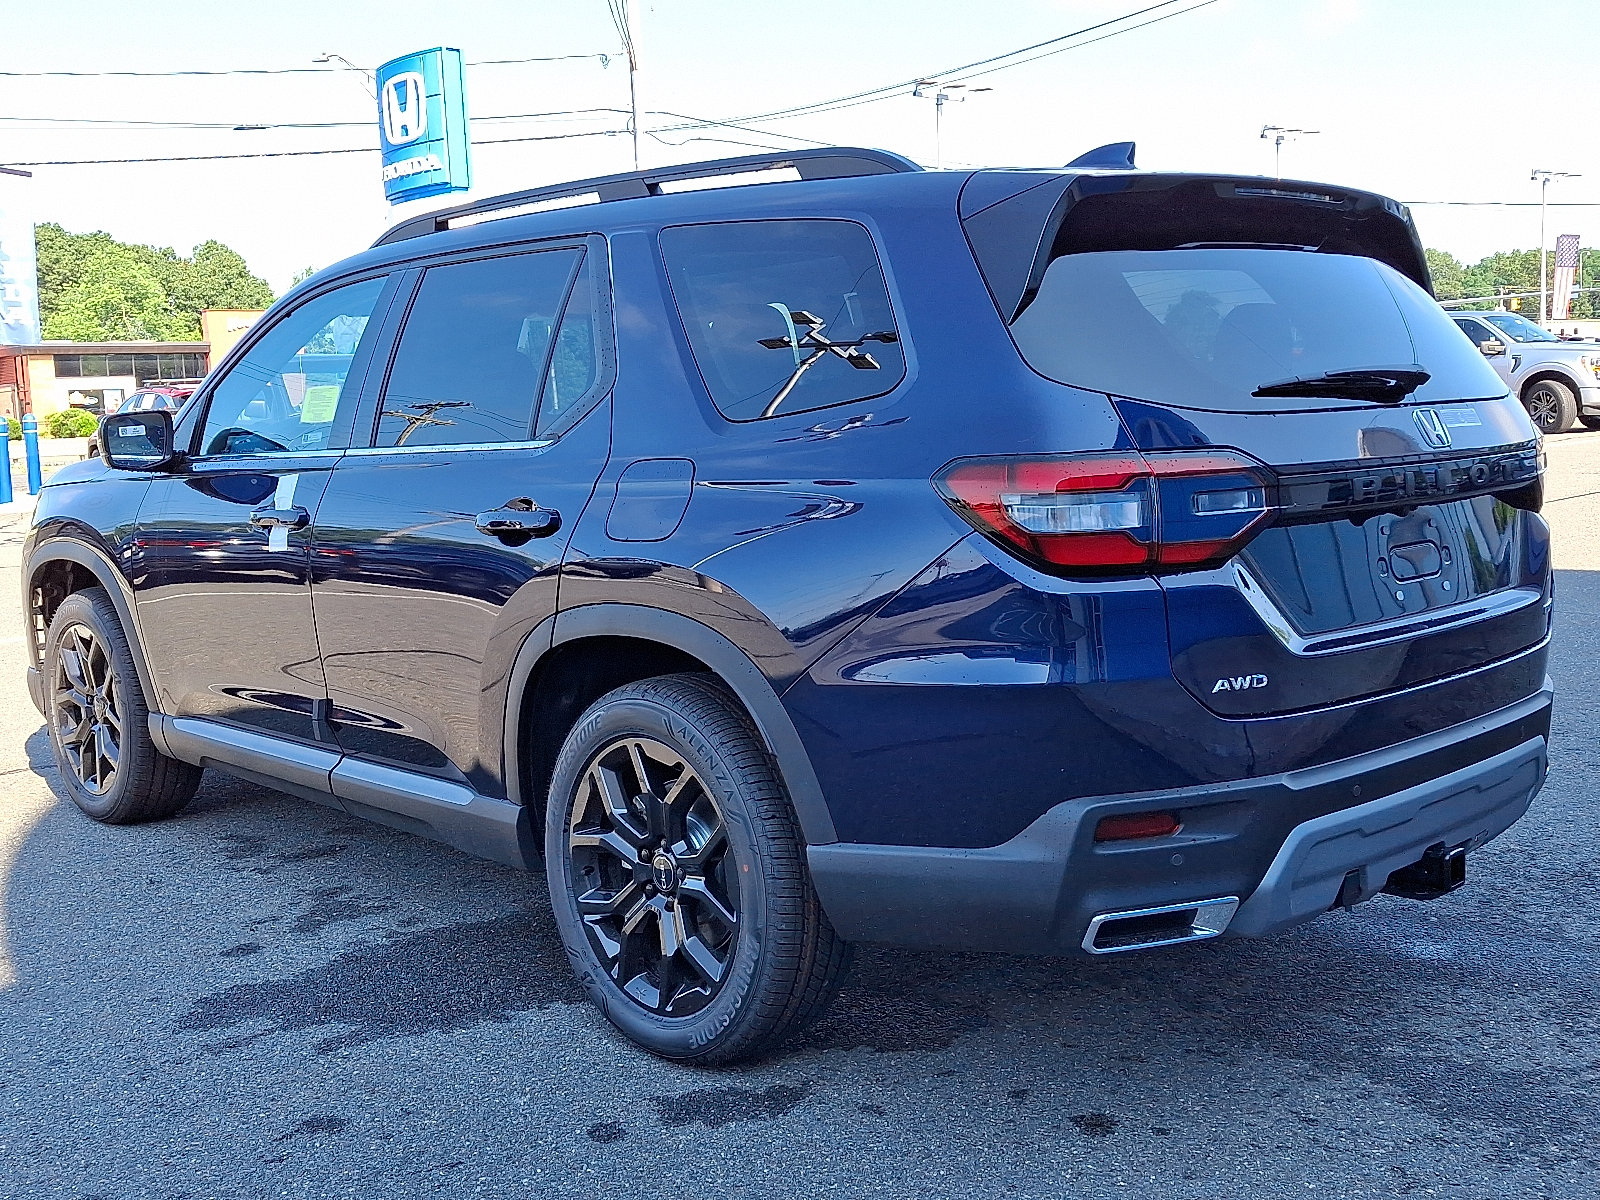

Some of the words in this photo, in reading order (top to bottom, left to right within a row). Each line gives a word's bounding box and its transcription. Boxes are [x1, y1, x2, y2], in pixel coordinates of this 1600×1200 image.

[382, 154, 444, 182] HONDA
[1352, 461, 1515, 503] PILOT
[1211, 673, 1268, 693] AWD
[677, 725, 735, 802] ALENZA
